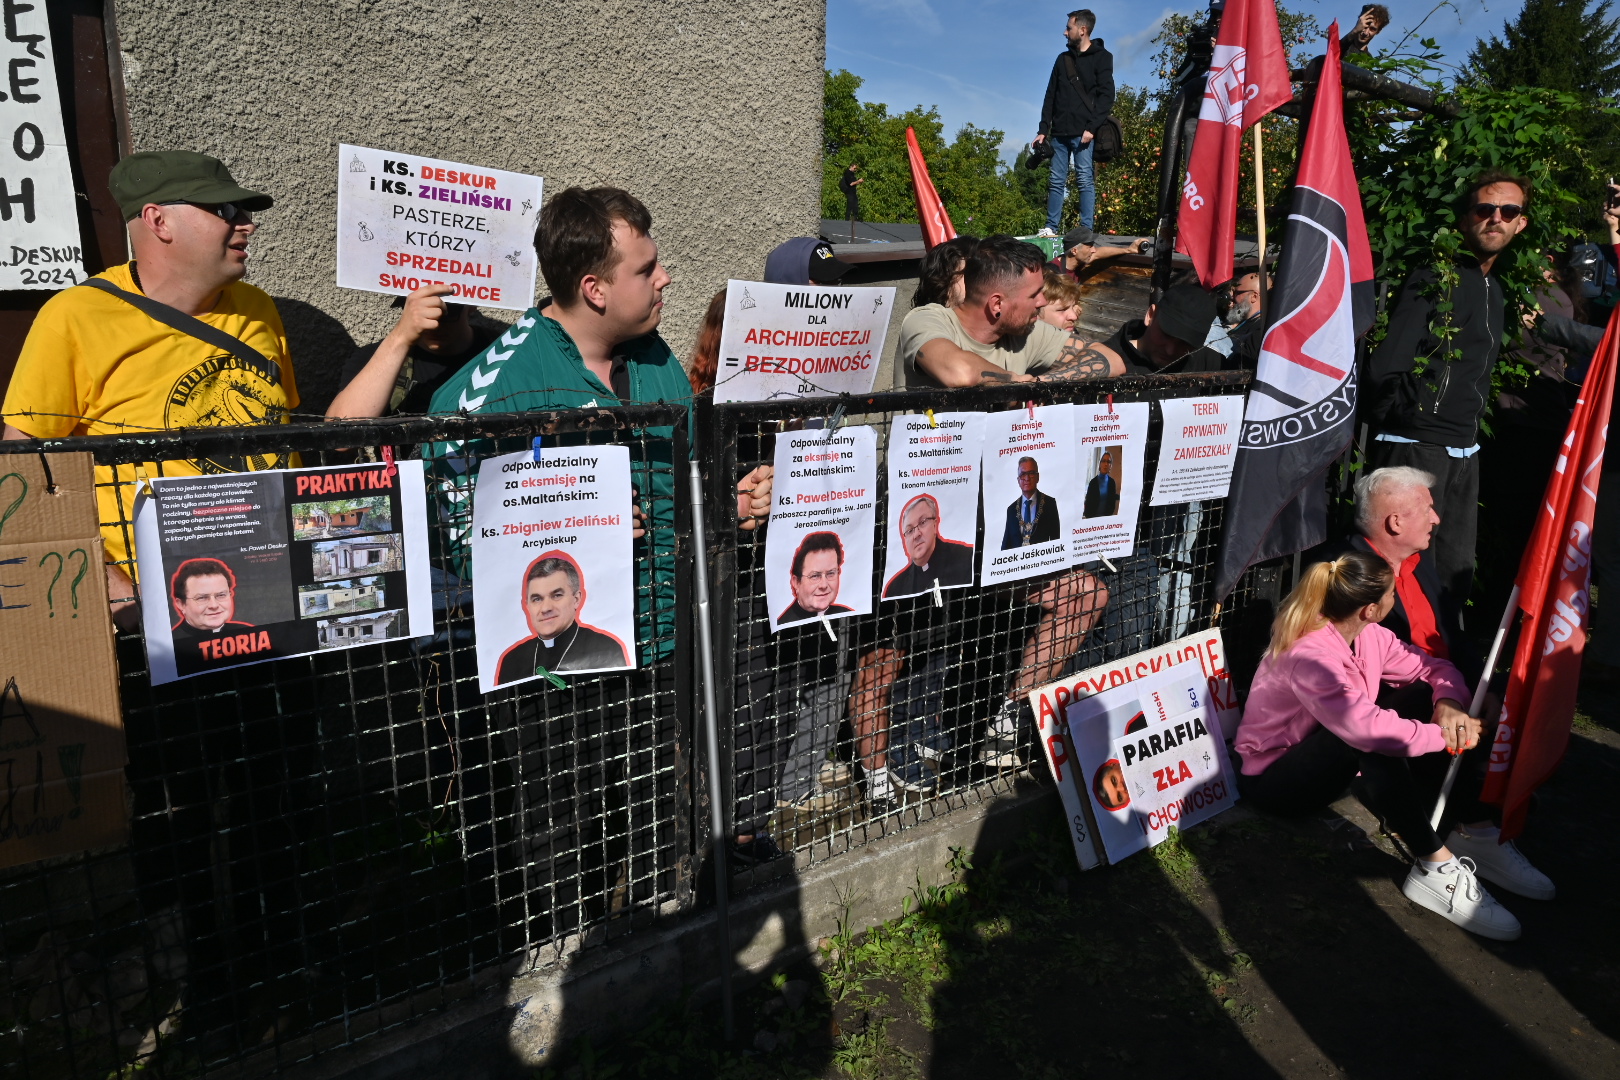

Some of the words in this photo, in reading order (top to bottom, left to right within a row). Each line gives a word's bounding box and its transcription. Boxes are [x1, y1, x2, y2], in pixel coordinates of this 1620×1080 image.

[0, 58, 41, 103] E
[13, 122, 44, 161] O
[383, 159, 414, 177] KS.
[421, 166, 497, 190] DESKUR
[370, 177, 376, 190] i
[382, 180, 413, 196] KS.
[418, 185, 512, 211] ZIELIŃSKI
[393, 205, 490, 233] PASTERZE,
[406, 230, 476, 252] KTÓRZY
[386, 252, 492, 278] SPRZEDALI
[20, 268, 78, 285] 2024
[785, 292, 853, 309] MILIONY
[808, 315, 827, 325] DLA
[744, 329, 871, 346] ARCHIDIECEZJI
[745, 351, 872, 374] BEZDOMNOŚĆ
[173, 359, 219, 402] ROZBRAT
[798, 384, 816, 393] DLA
[1094, 413, 1119, 422] Eksmisje
[1193, 403, 1220, 415] TEREN
[907, 420, 965, 432] Odpowedzialny
[1012, 419, 1042, 432] Eksmisje
[1090, 425, 1098, 433] za
[1099, 423, 1120, 433] cichym
[1182, 423, 1228, 438] PRYWATNY
[920, 433, 952, 444] eksmisję
[1017, 431, 1045, 443] cichym
[999, 441, 1055, 457] przyzwoleniem:
[1174, 443, 1232, 461] ZAMIESZKAŁY
[502, 456, 598, 474] Odpowiedzialny
[899, 470, 910, 478] ks.
[912, 466, 949, 477] Waldemar
[950, 464, 972, 473] Hanas
[296, 469, 393, 496] PRAKTYKA
[505, 480, 518, 489] za
[521, 474, 577, 488] eksmisję
[579, 474, 595, 483] na
[902, 481, 925, 489] Ekonom
[503, 490, 598, 507] os.Maltańskim:
[779, 495, 794, 506] ks.
[831, 488, 865, 501] Deskur
[772, 510, 807, 522] proboszcz
[857, 502, 871, 510] Jana
[482, 527, 499, 538] ks.
[503, 519, 562, 536] Zbigniew
[565, 514, 620, 528] Zieliński
[794, 516, 849, 529] Jerozolimskiego
[522, 534, 577, 548] Arcybiskup
[991, 553, 1018, 566] Jacek
[1020, 543, 1065, 561] Jaśkowiak
[990, 565, 1019, 577] Prezydent
[1021, 560, 1040, 571] Miasta
[199, 631, 271, 662] TEORIA
[1122, 717, 1208, 767] PARAFIA
[1152, 760, 1193, 793] ZŁA
[1147, 780, 1227, 832] CHCIWOŚCI
